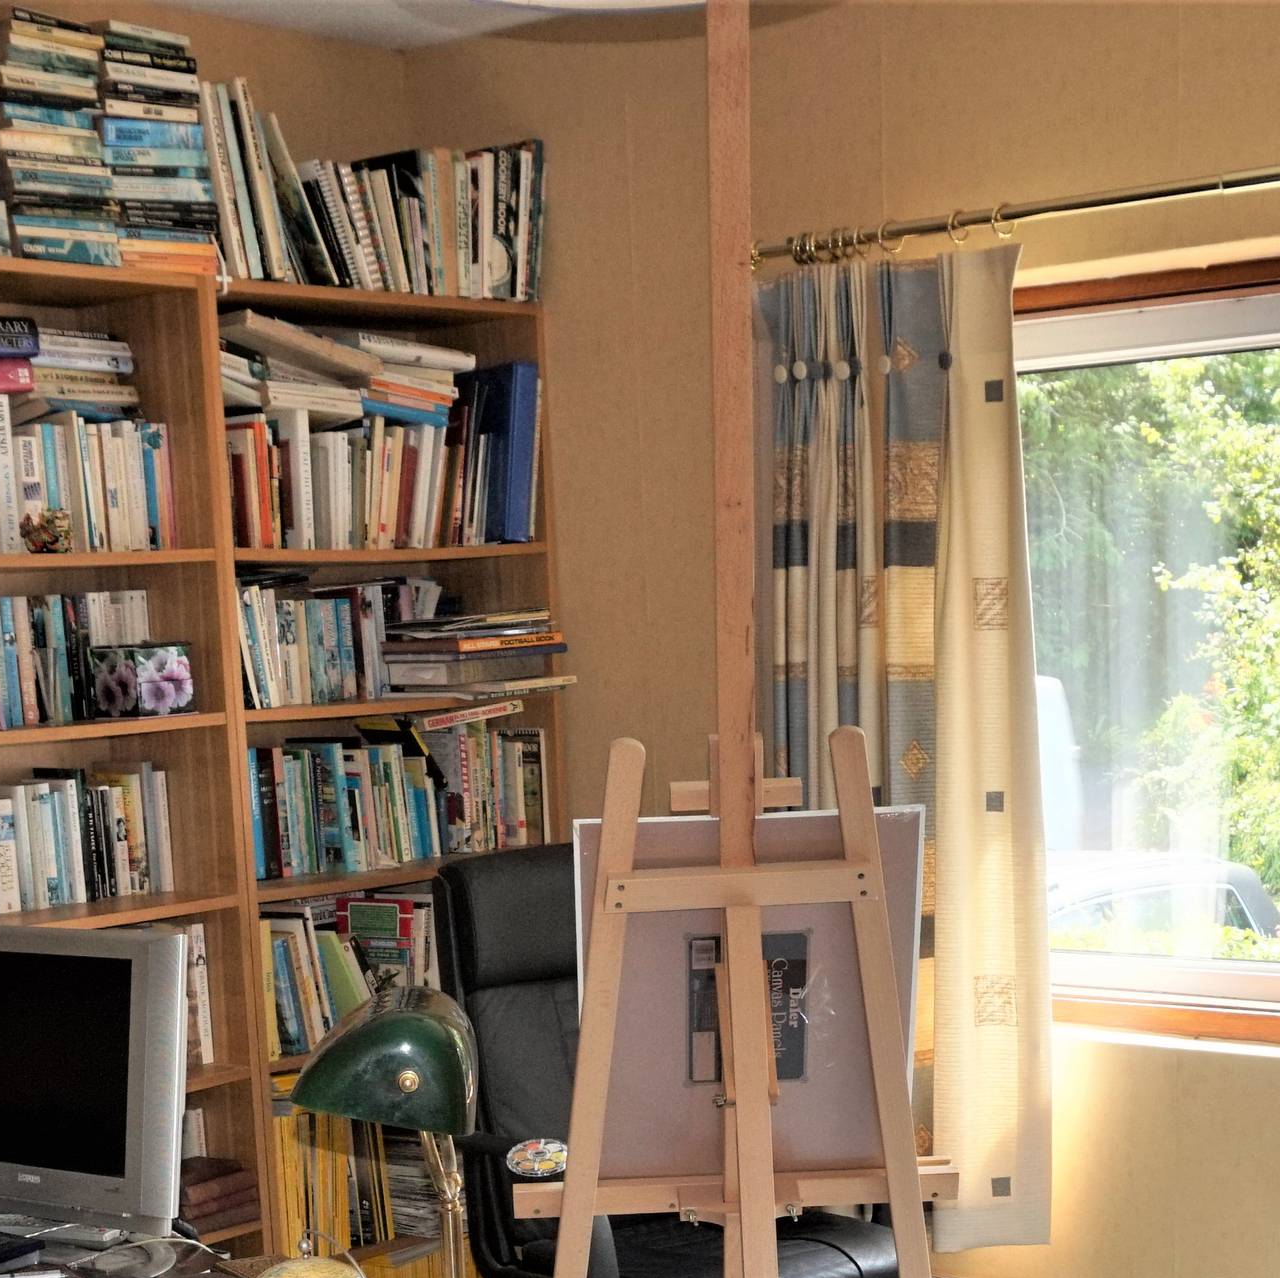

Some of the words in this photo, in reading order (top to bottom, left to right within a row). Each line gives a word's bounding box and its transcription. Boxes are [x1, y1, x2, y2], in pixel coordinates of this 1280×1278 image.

[497, 149, 509, 201] COOKERY
[496, 203, 508, 235] BOOK
[500, 636, 536, 647] FOOTBALL
[537, 634, 556, 643] BOOK
[770, 957, 788, 1006] Canvas
[787, 986, 800, 1028] Daler
[772, 1009, 787, 1058] Panels
